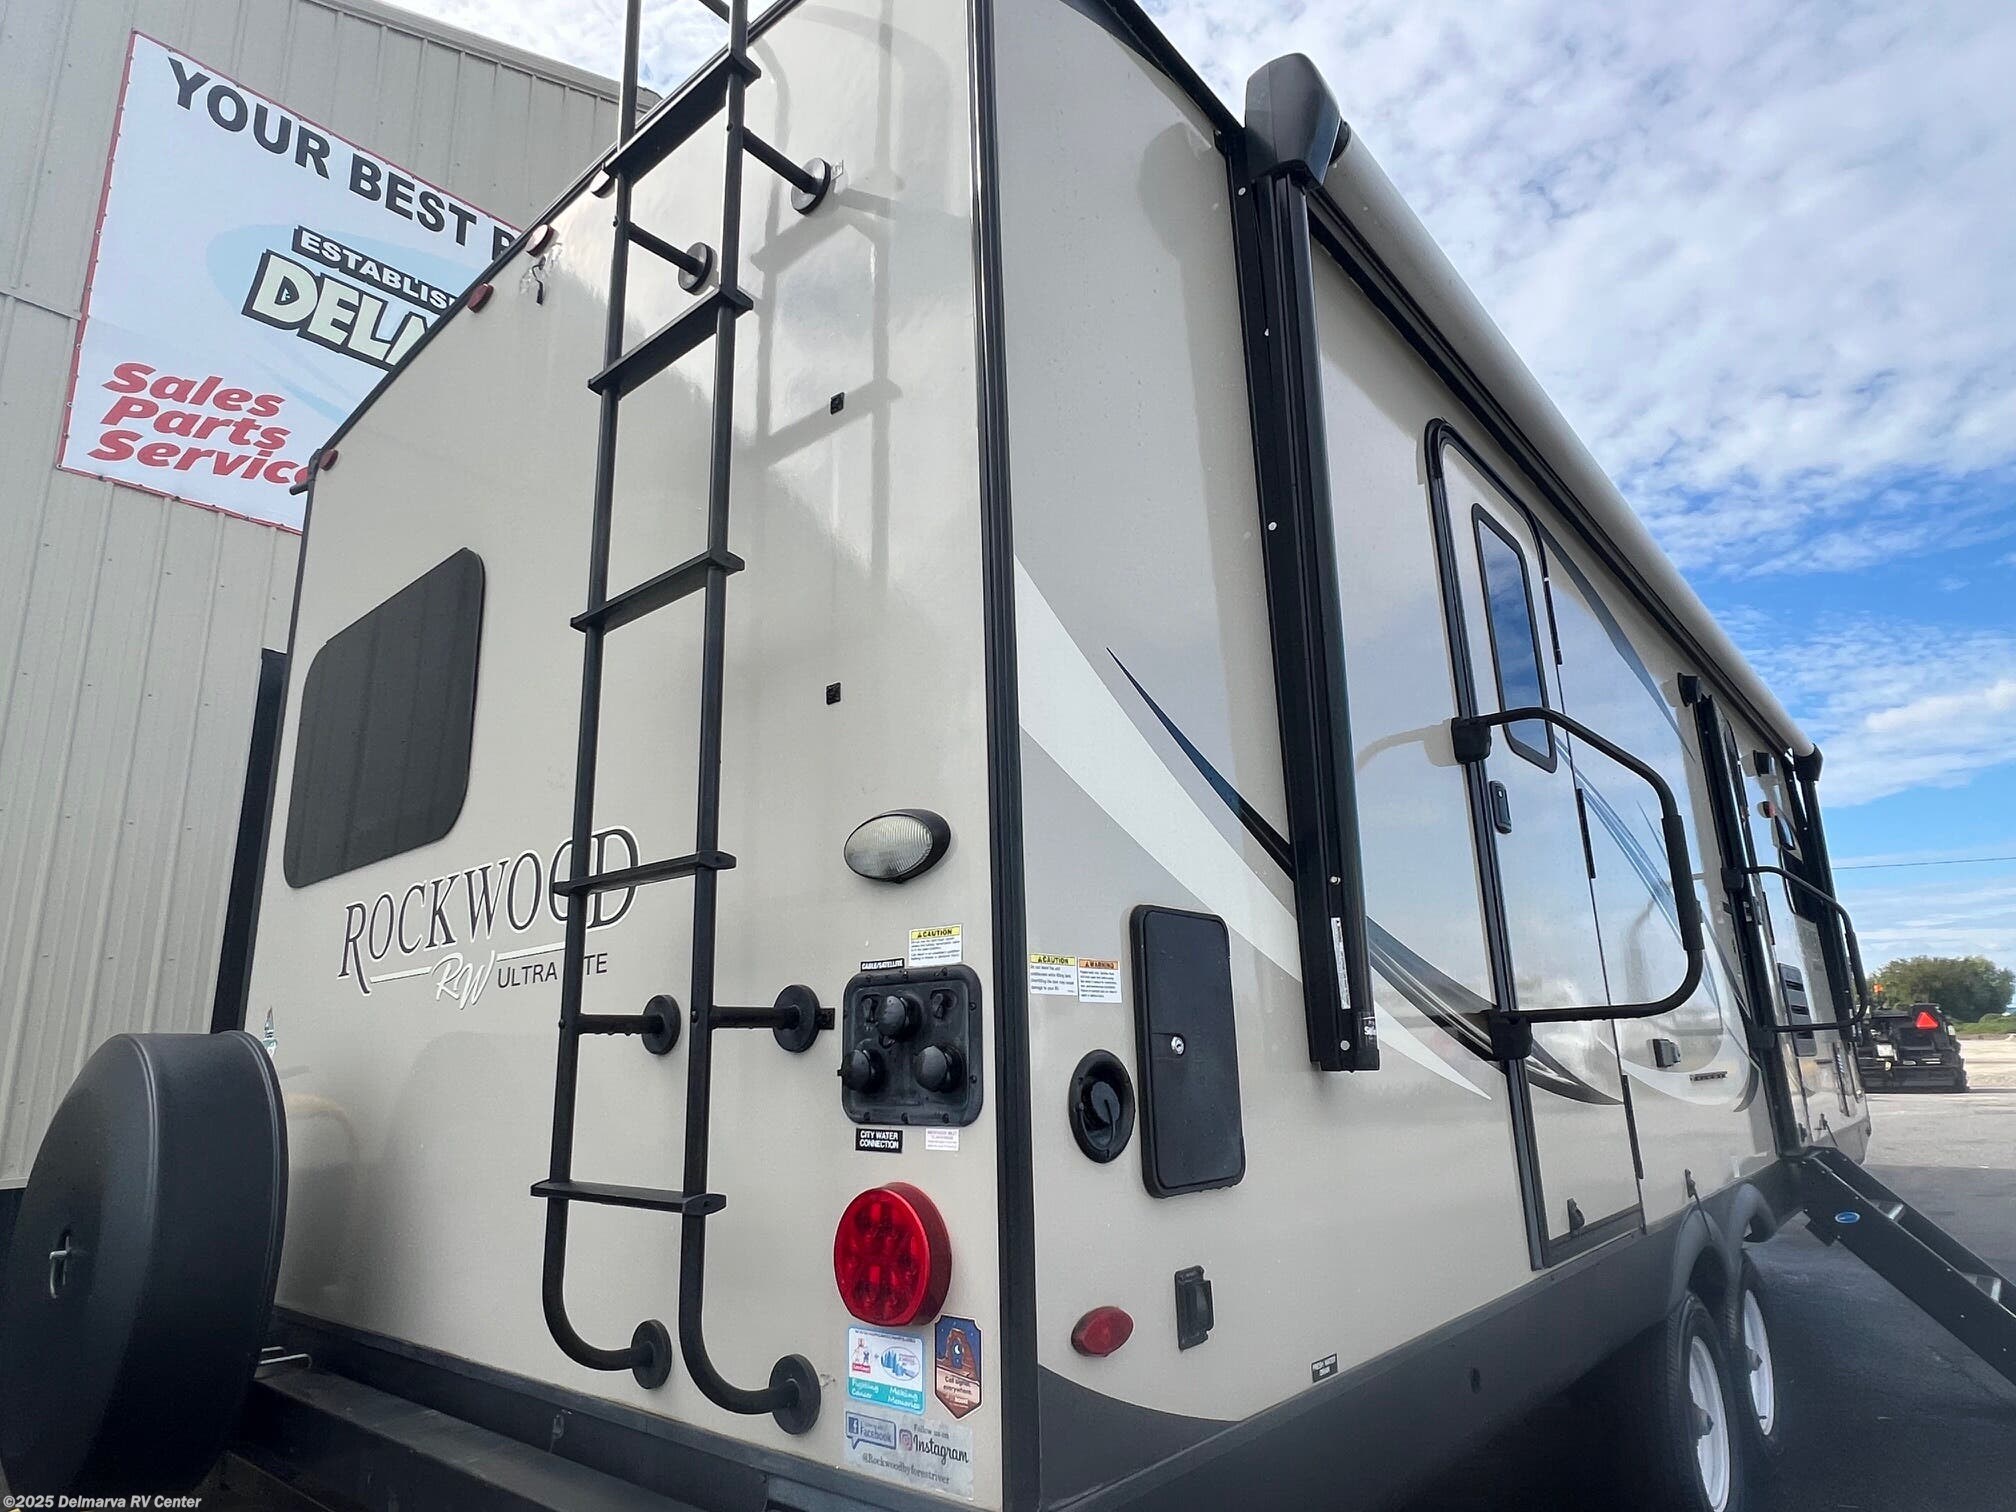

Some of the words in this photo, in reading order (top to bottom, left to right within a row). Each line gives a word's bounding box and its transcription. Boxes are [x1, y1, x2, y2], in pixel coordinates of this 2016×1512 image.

[168, 57, 331, 180] YOUR
[349, 152, 477, 247] BEST
[101, 362, 286, 418] Sales
[100, 395, 292, 451] Parts
[923, 929, 953, 938] CAUTION
[498, 960, 558, 989] ULTRA
[1042, 956, 1069, 965] CAUTION
[859, 1140, 899, 1149] CONNECTION
[860, 1130, 875, 1139] CITY
[876, 1131, 899, 1140] WATER
[912, 1434, 969, 1466] Instagram
